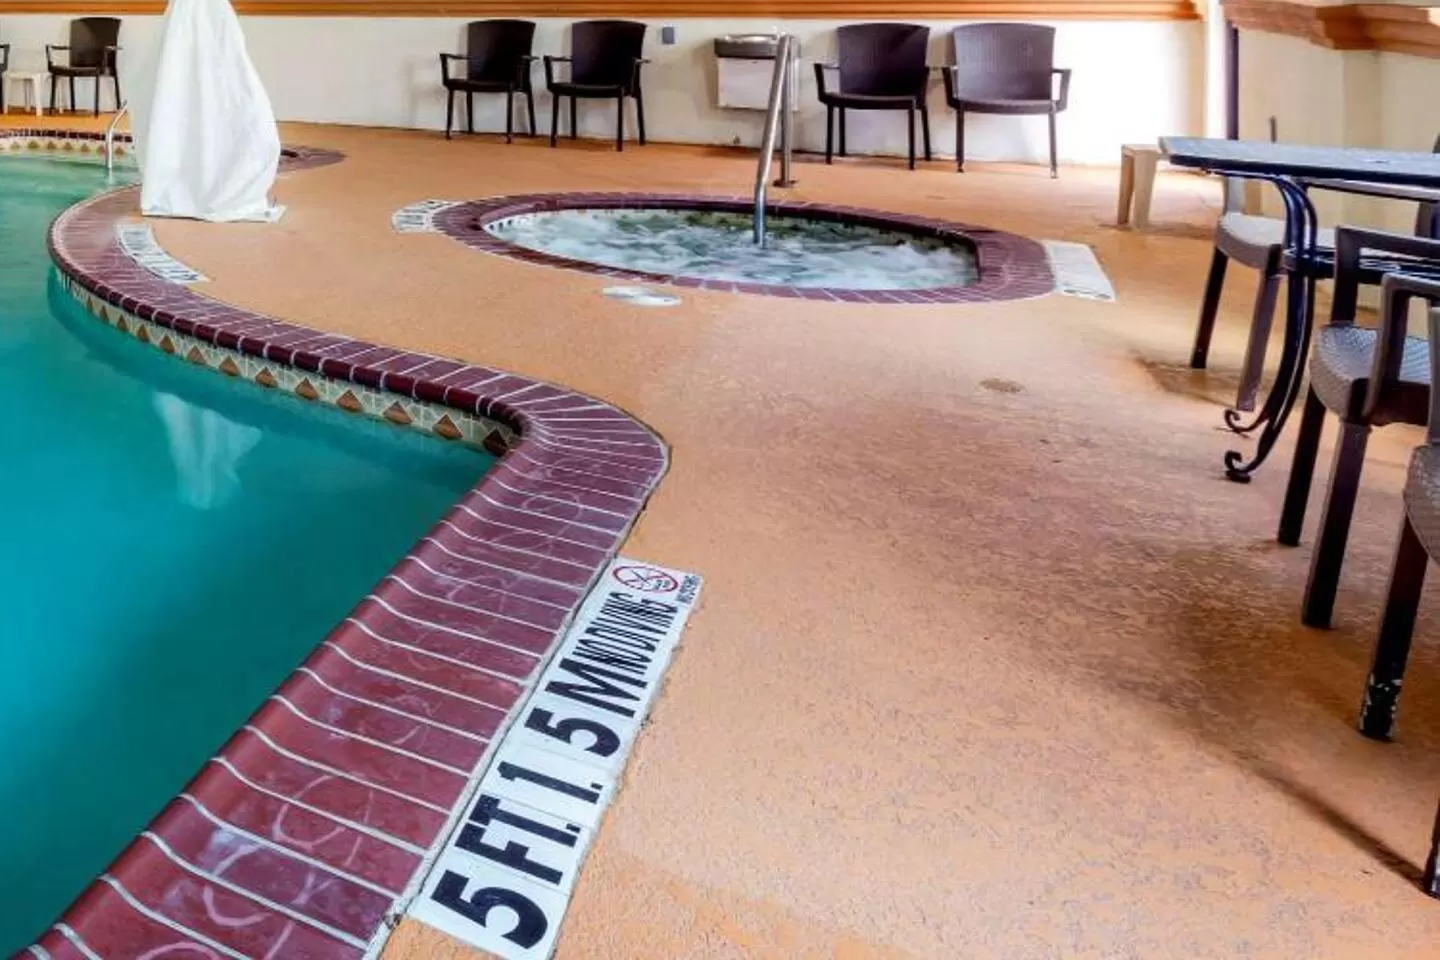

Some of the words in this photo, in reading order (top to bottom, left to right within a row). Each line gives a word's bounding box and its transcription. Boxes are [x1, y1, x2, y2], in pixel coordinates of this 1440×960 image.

[583, 591, 679, 653] DIVING
[544, 657, 648, 718] M
[453, 793, 581, 886] FT.
[429, 869, 549, 950] 5
